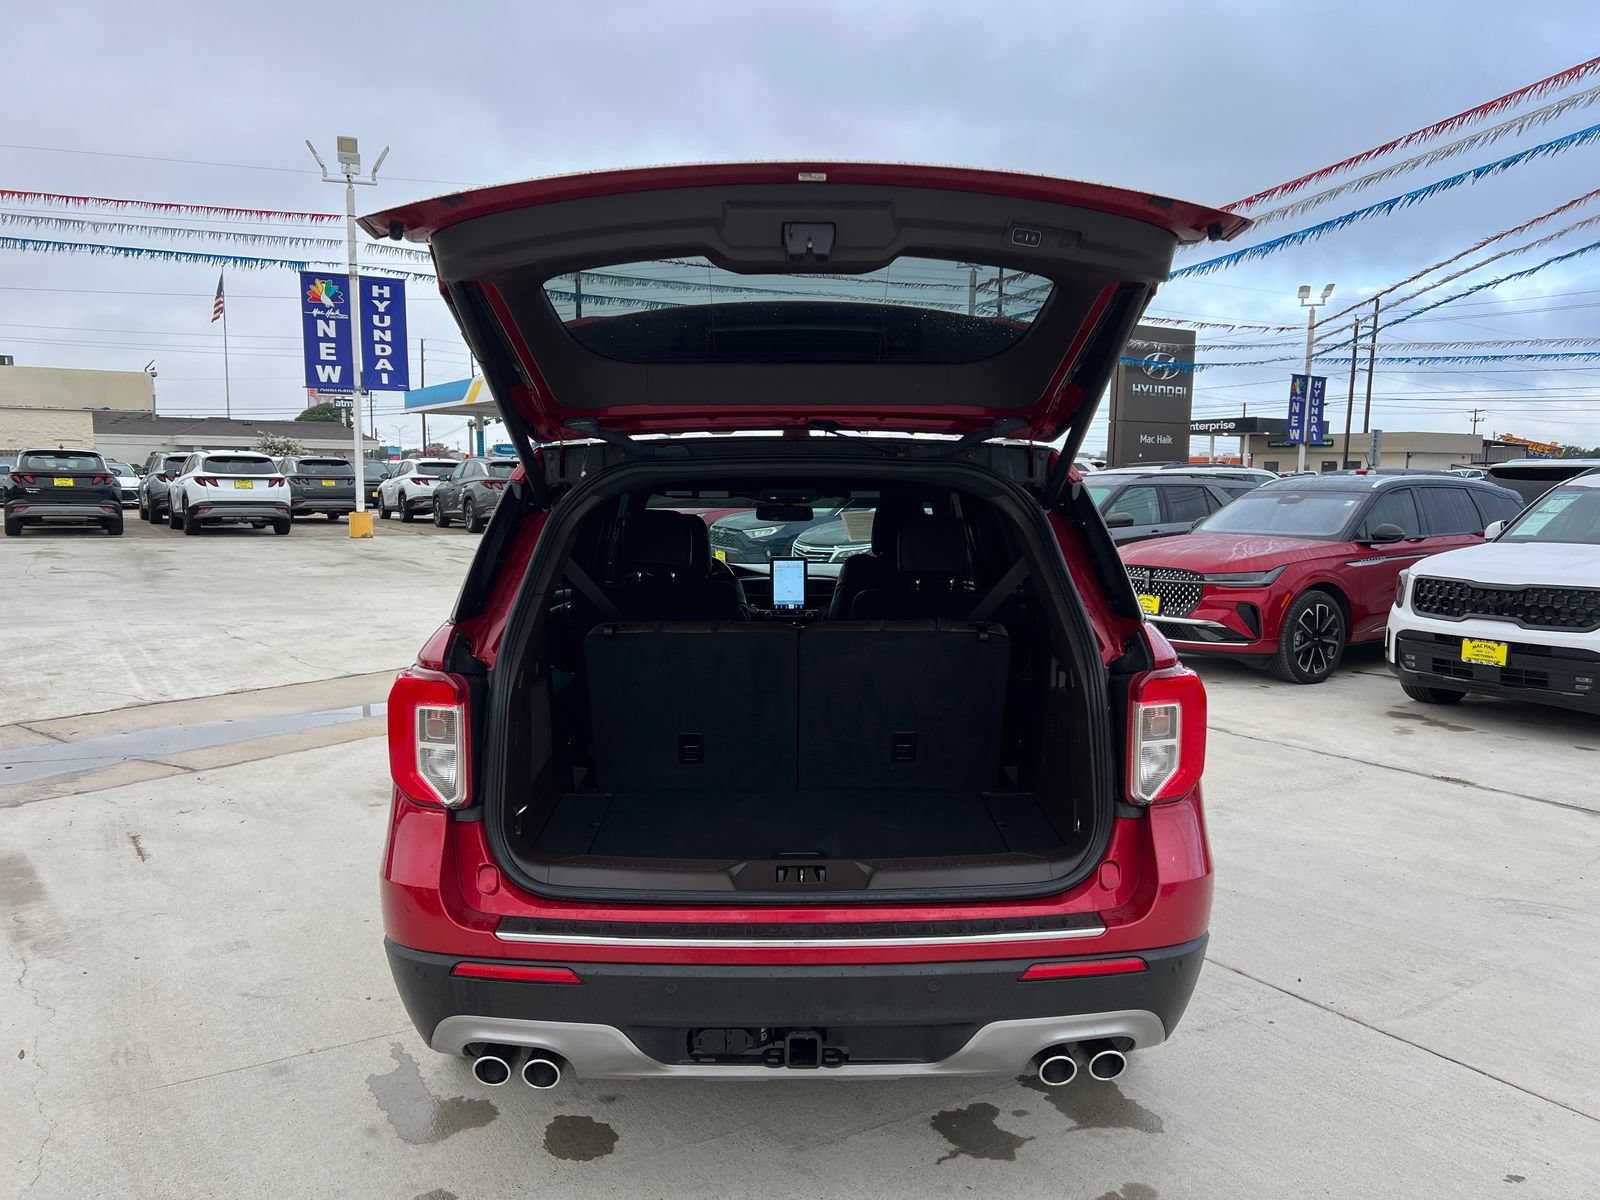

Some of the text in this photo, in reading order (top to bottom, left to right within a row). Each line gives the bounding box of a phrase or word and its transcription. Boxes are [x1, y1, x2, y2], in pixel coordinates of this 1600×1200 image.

[371, 285, 394, 384] HYUNDAI
[315, 319, 341, 383] NEW
[335, 399, 353, 407] atm
[1132, 383, 1187, 398] HYUNDAI
[1289, 402, 1300, 440] NEW
[1310, 380, 1322, 441] HYUNDAI
[1139, 434, 1173, 445] Mac Haik
[1190, 421, 1236, 432] nterprise
